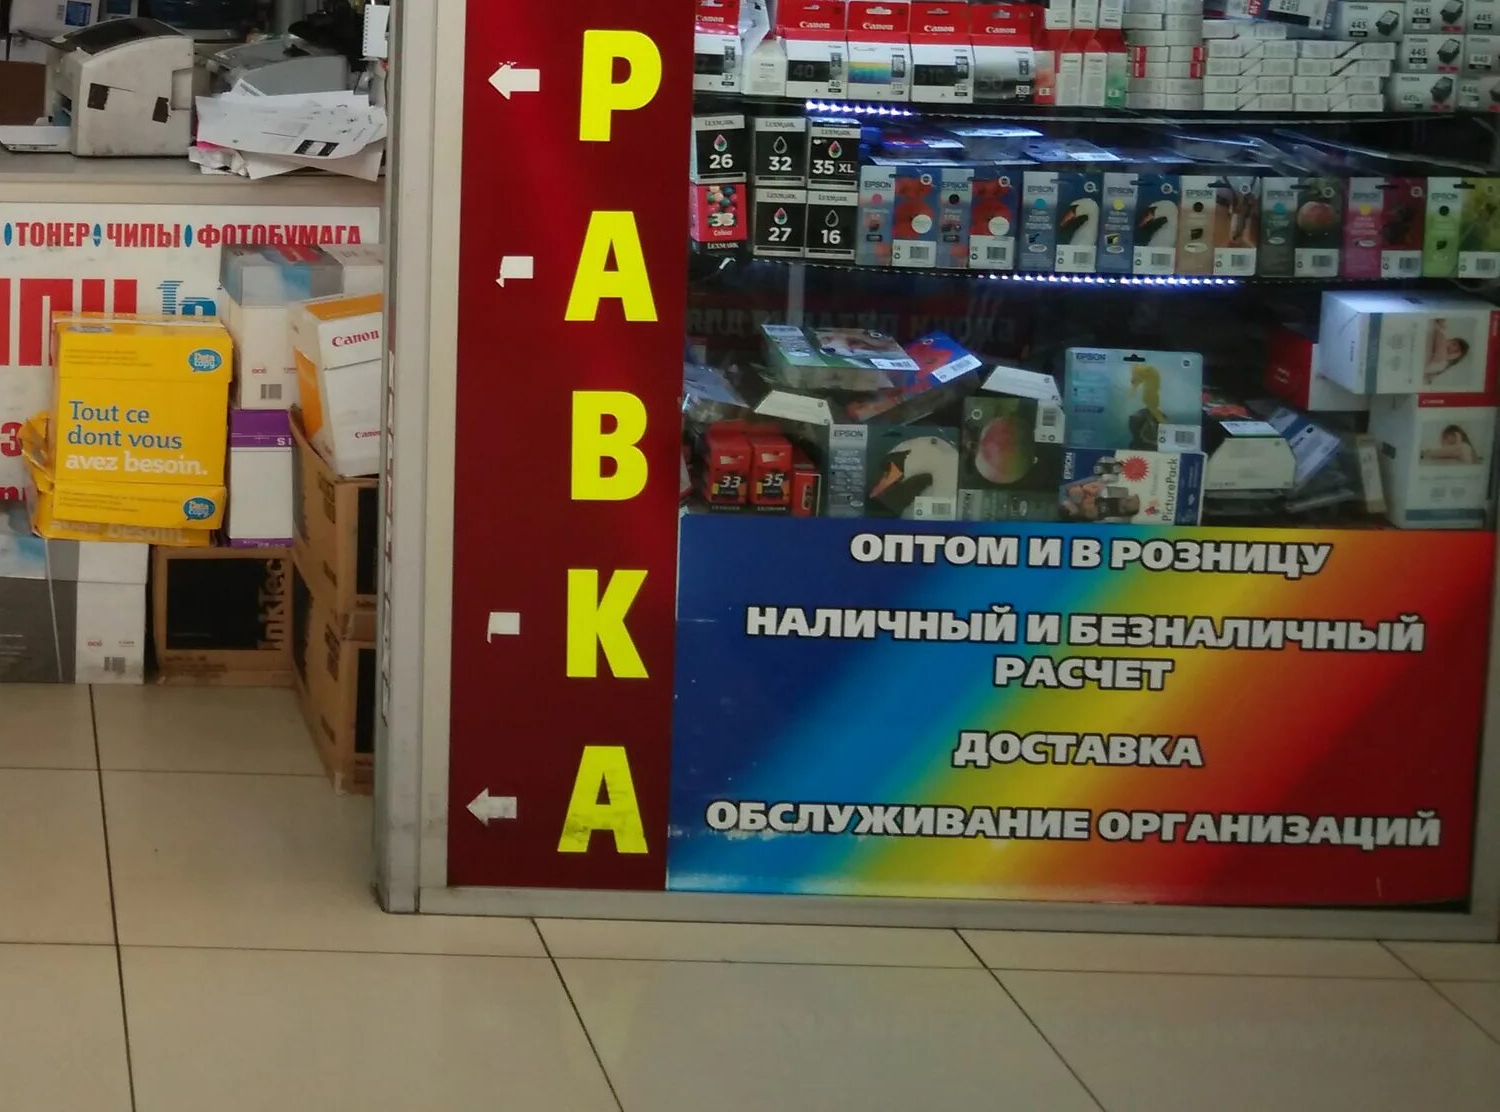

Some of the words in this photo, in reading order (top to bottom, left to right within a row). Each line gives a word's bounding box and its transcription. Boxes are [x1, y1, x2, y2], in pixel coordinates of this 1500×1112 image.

[709, 154, 734, 169] 26
[768, 156, 792, 172] 32
[812, 160, 834, 175] 35
[15, 222, 91, 247] ТОНЕР
[106, 224, 180, 249] ЧИПЫ
[768, 227, 792, 242] 27
[821, 229, 841, 244] 16
[332, 329, 380, 348] Canon
[69, 400, 119, 422] Tout
[125, 409, 150, 424] ce
[67, 424, 122, 447] dont
[128, 434, 182, 450] vous
[66, 454, 118, 471] avez
[124, 451, 209, 475] besoin.
[850, 532, 1021, 568] ОПТОМ
[1026, 536, 1062, 567] И
[1070, 537, 1103, 569] В
[1109, 538, 1332, 579] РОЗНИЦУ
[746, 604, 1017, 645] НАЛИЧНЫЙ
[1025, 612, 1060, 644] И
[1068, 611, 1426, 653] БЕЗНАЛИЧНЫЙ
[993, 656, 1174, 691] РАСЧЕТ
[951, 730, 1203, 769] ДОСТАВКА
[705, 799, 1090, 842] ОБСЛУЖИВАНИЕ
[1097, 805, 1443, 851] ОРГАНИЗАЦИЙ
